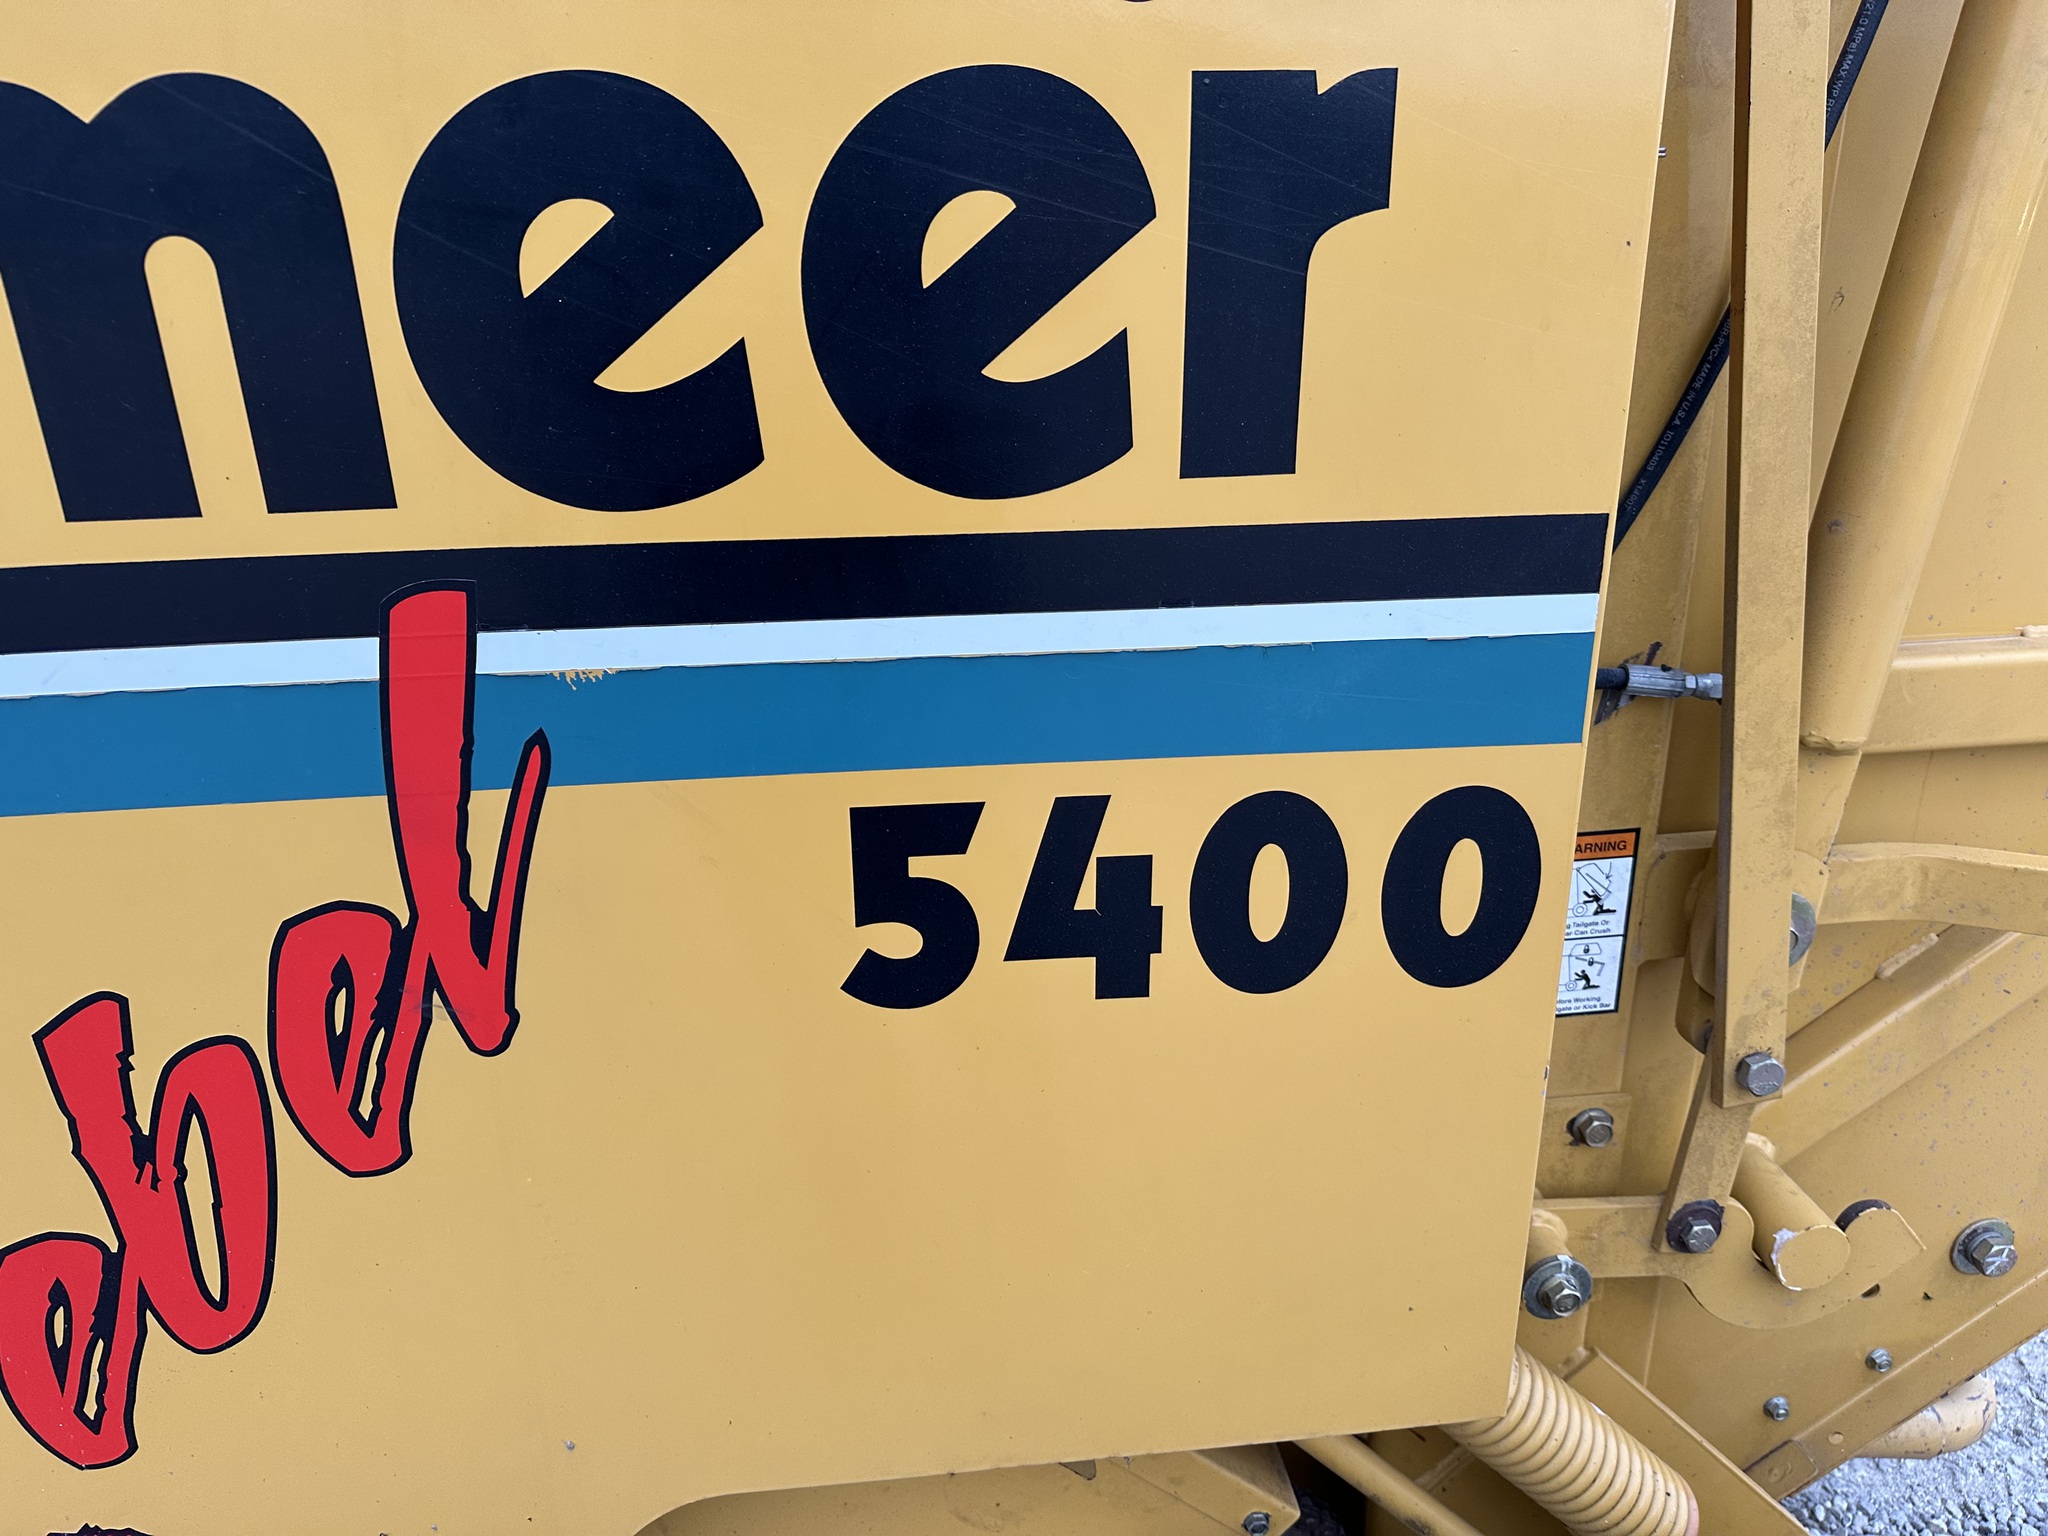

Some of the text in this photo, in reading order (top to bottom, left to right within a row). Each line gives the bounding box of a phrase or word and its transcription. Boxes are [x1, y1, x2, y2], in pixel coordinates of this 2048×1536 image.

[1837, 54, 1854, 78] MAX
[1831, 80, 1844, 97] WP
[0, 60, 1399, 522] meer
[1691, 362, 1711, 389] MADE
[1687, 390, 1697, 401] IN
[1671, 401, 1690, 426] U.S.A.
[840, 784, 1542, 1010] 5400
[1589, 927, 1611, 935] Crush
